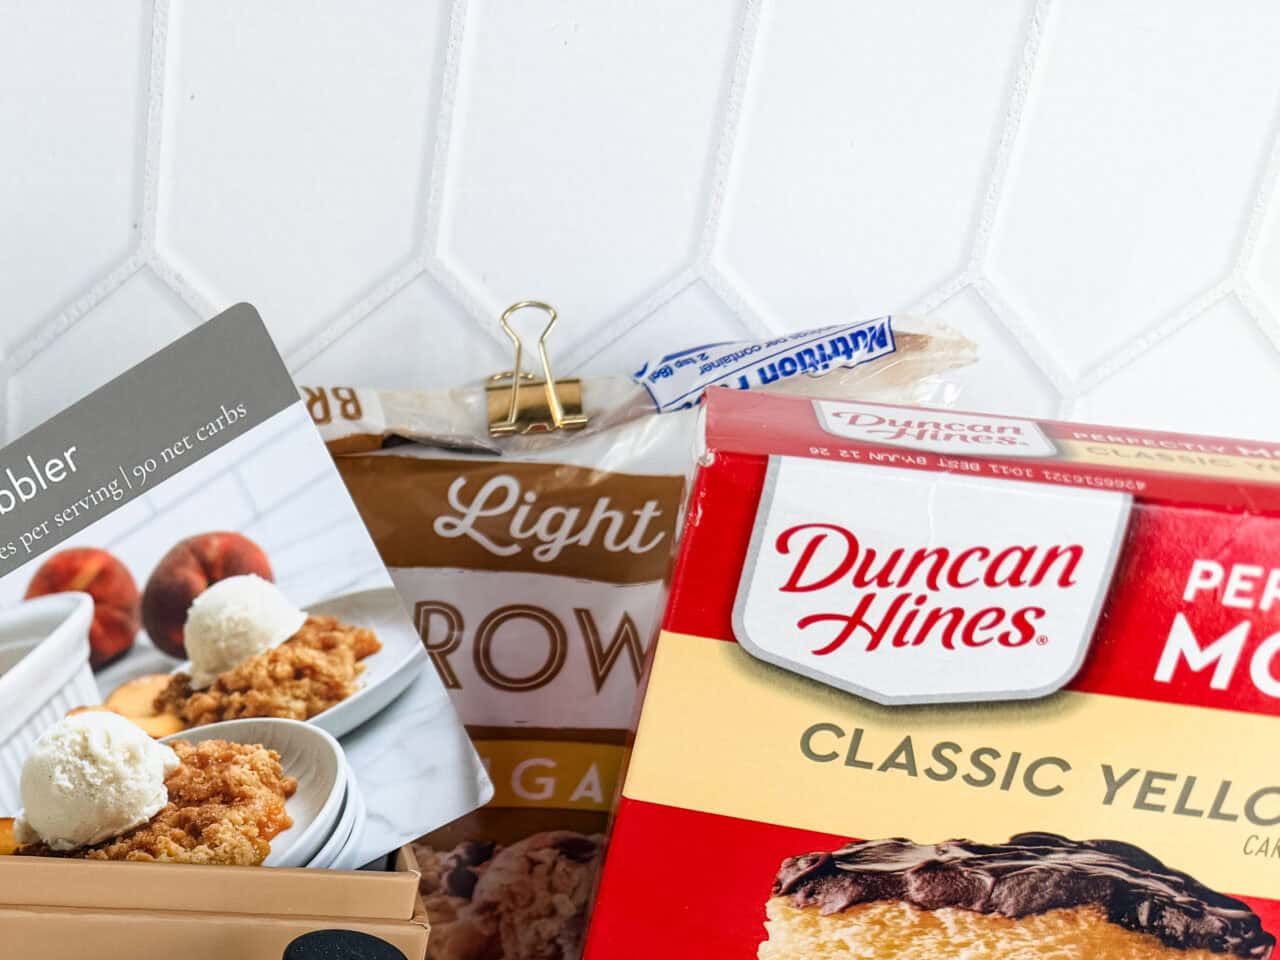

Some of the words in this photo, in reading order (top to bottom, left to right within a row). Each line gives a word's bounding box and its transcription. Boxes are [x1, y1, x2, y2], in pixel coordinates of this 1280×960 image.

[698, 345, 762, 376] container
[758, 322, 888, 385] Nutrition
[300, 386, 362, 426] BR
[832, 410, 1025, 438] Duncan
[867, 427, 1020, 448] Hines
[20, 521, 49, 553] per
[54, 479, 125, 527] serving
[133, 457, 158, 486] 90
[160, 436, 194, 464] net
[196, 401, 248, 442] carbs
[937, 457, 980, 473] BEST
[433, 474, 665, 563] Light
[775, 522, 1085, 594] Duncan
[414, 600, 650, 695] ROW
[796, 592, 1047, 656] Hines
[798, 721, 1073, 798] CLASSIC
